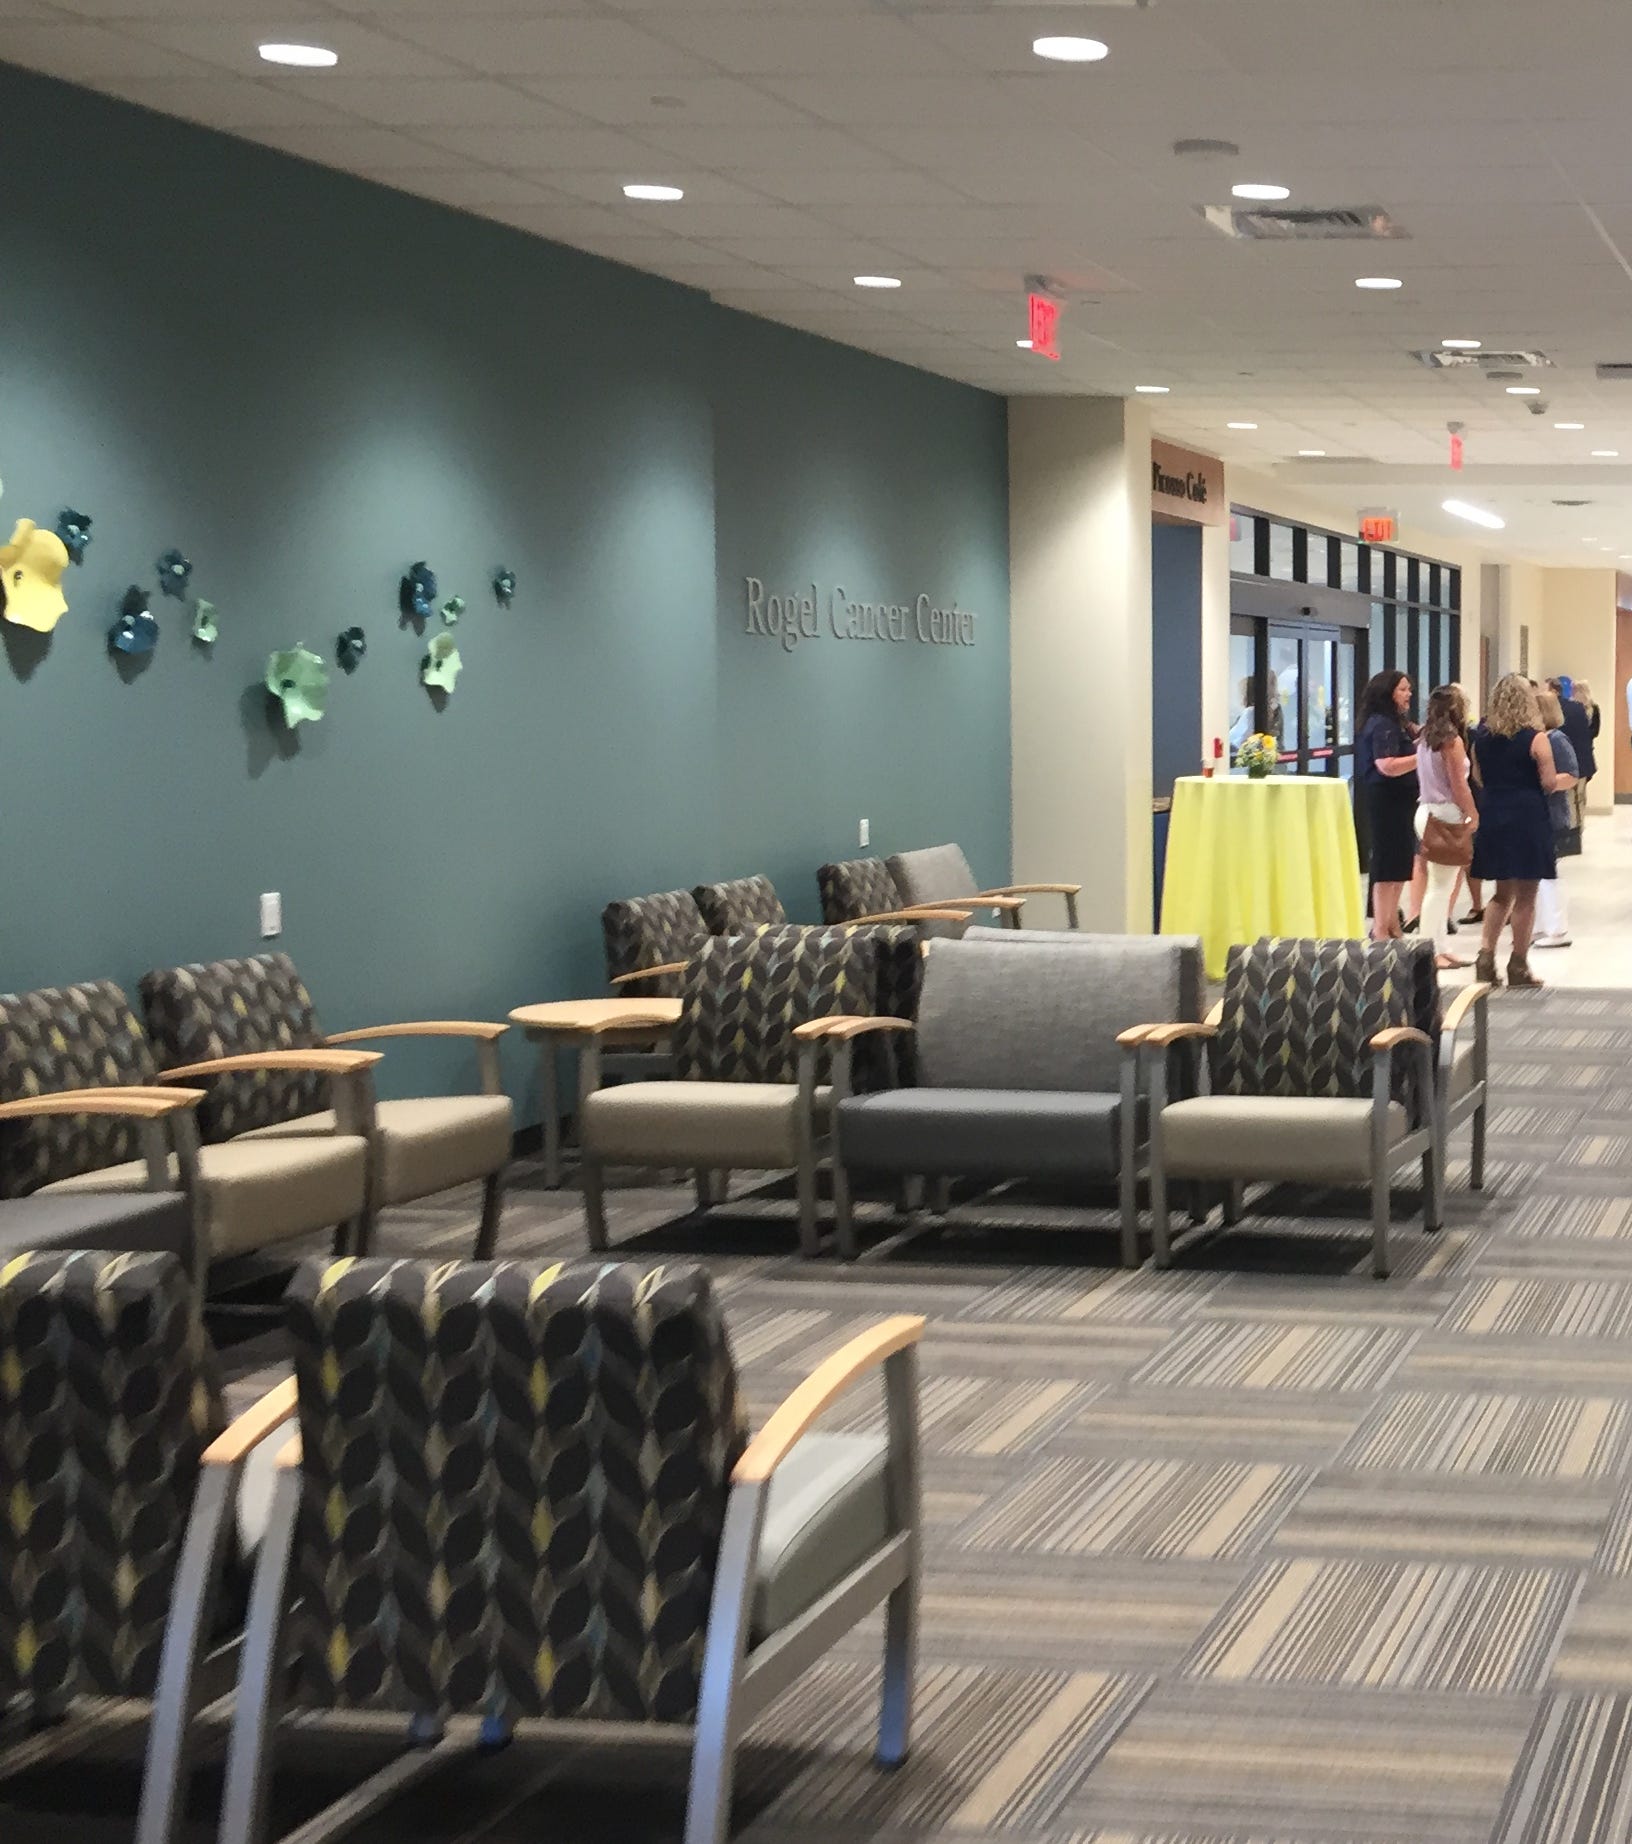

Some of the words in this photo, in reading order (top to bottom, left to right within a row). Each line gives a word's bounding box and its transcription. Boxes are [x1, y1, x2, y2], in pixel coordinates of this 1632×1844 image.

[744, 576, 820, 653] Rogel
[829, 585, 909, 642] Cancer
[915, 593, 977, 646] Center
